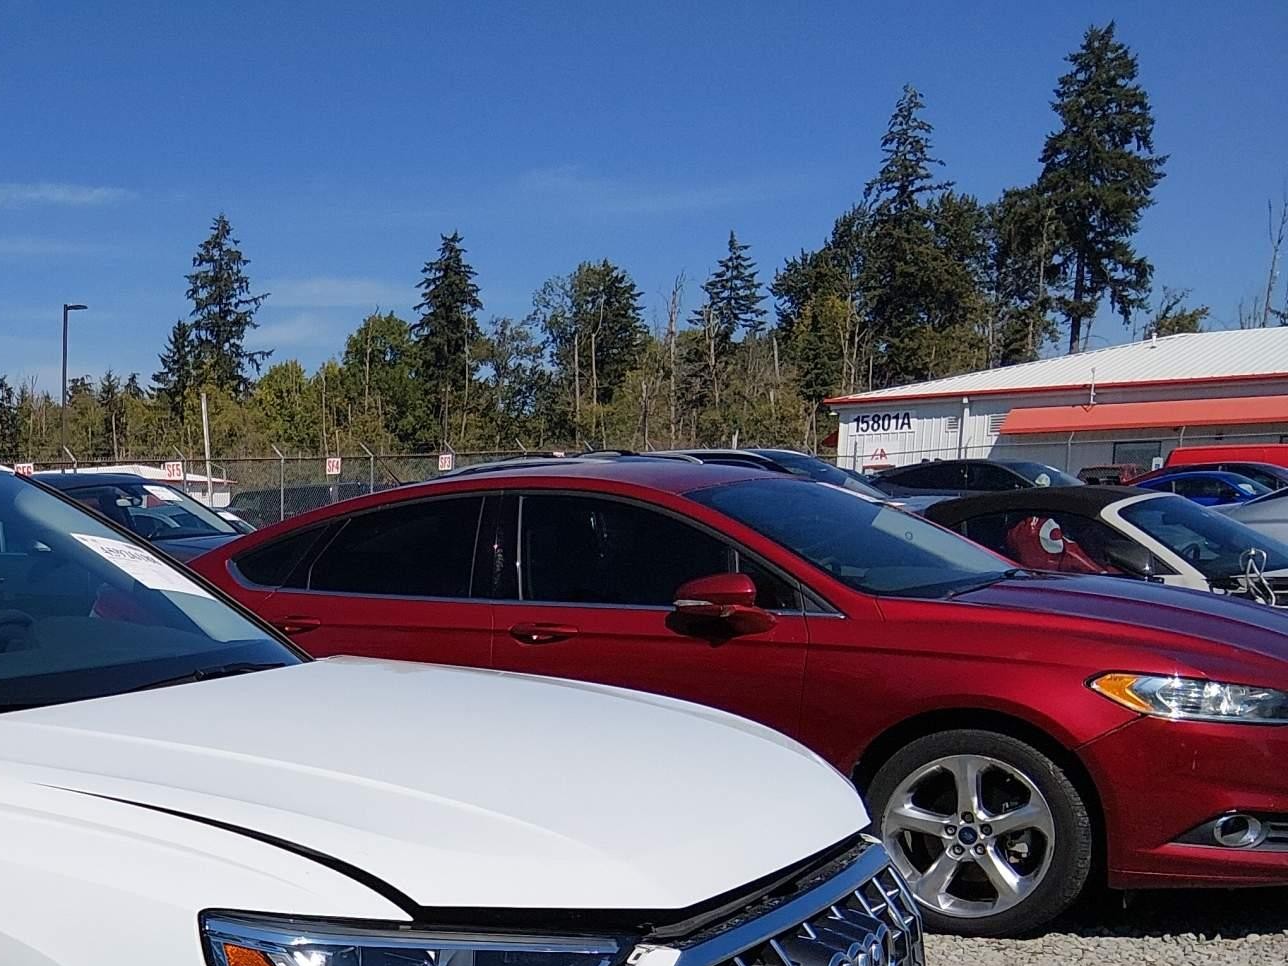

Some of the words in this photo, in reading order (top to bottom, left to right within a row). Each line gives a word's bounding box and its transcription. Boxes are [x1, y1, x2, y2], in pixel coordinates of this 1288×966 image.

[853, 412, 911, 432] 15801A
[327, 460, 340, 473] SF4
[439, 456, 451, 469] SF3
[166, 463, 182, 477] SF5
